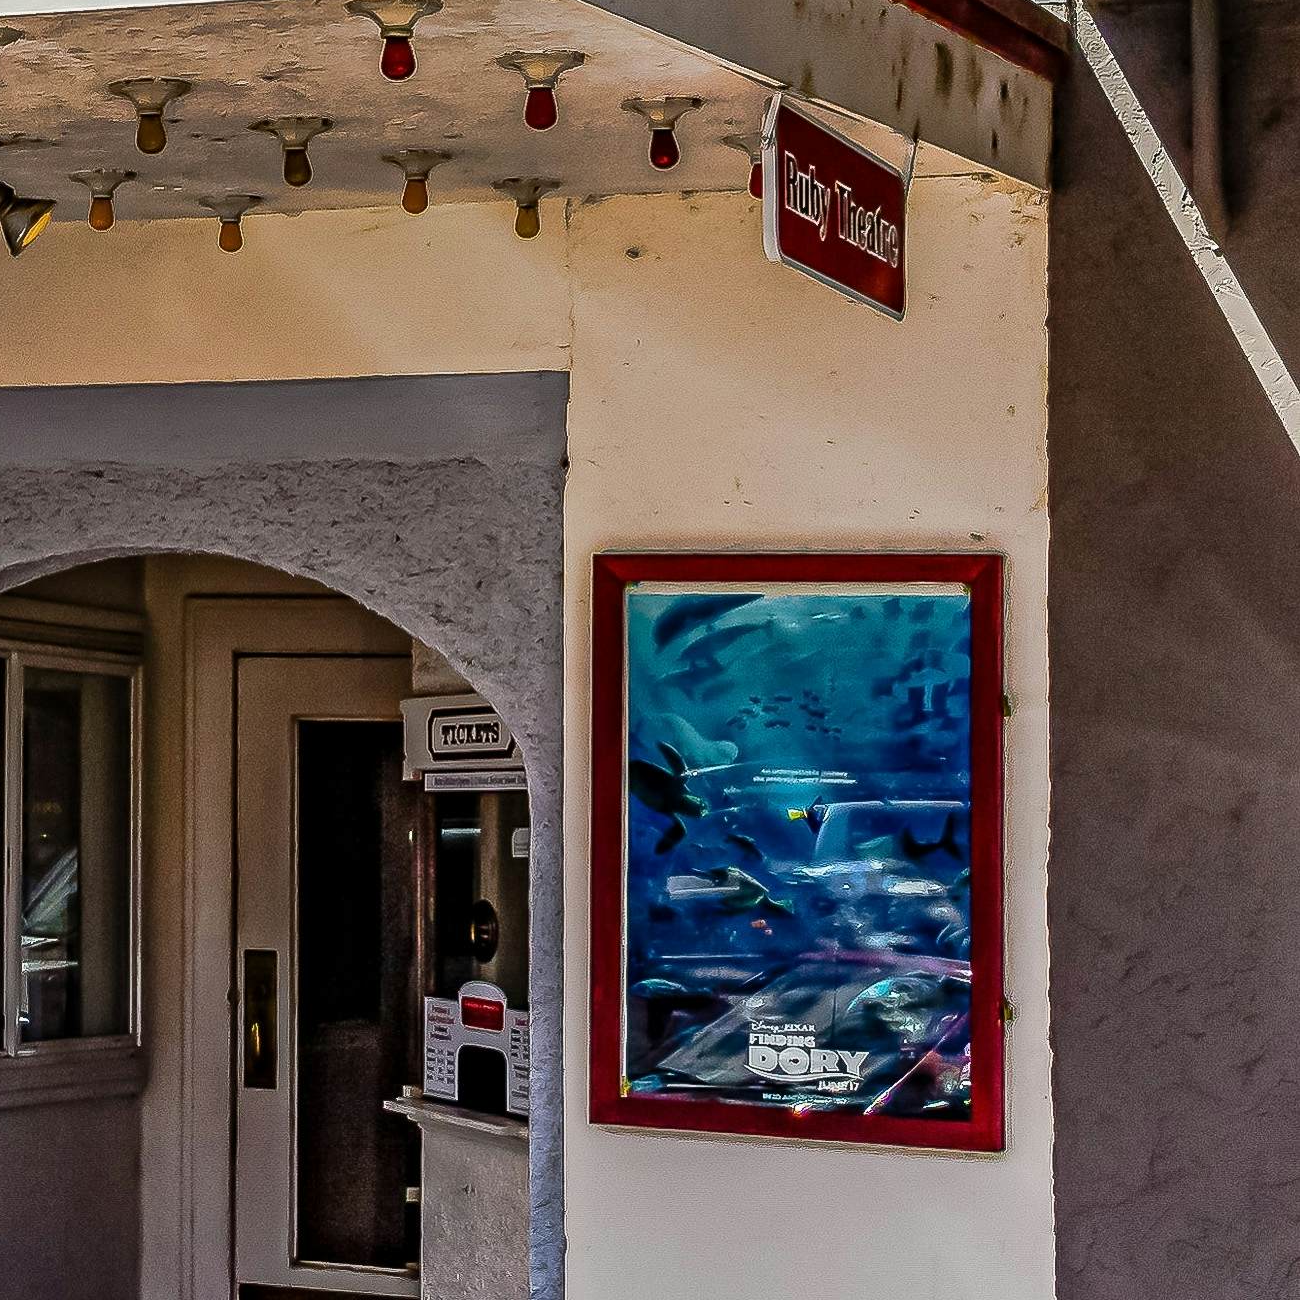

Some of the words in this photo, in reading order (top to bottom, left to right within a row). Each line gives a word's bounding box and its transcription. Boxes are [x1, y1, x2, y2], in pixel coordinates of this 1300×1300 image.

[784, 150, 830, 241] Ruby
[835, 180, 899, 268] Theatre
[441, 722, 501, 746] TICKETS
[749, 1033, 816, 1048] FINDING
[748, 1045, 870, 1076] DORY
